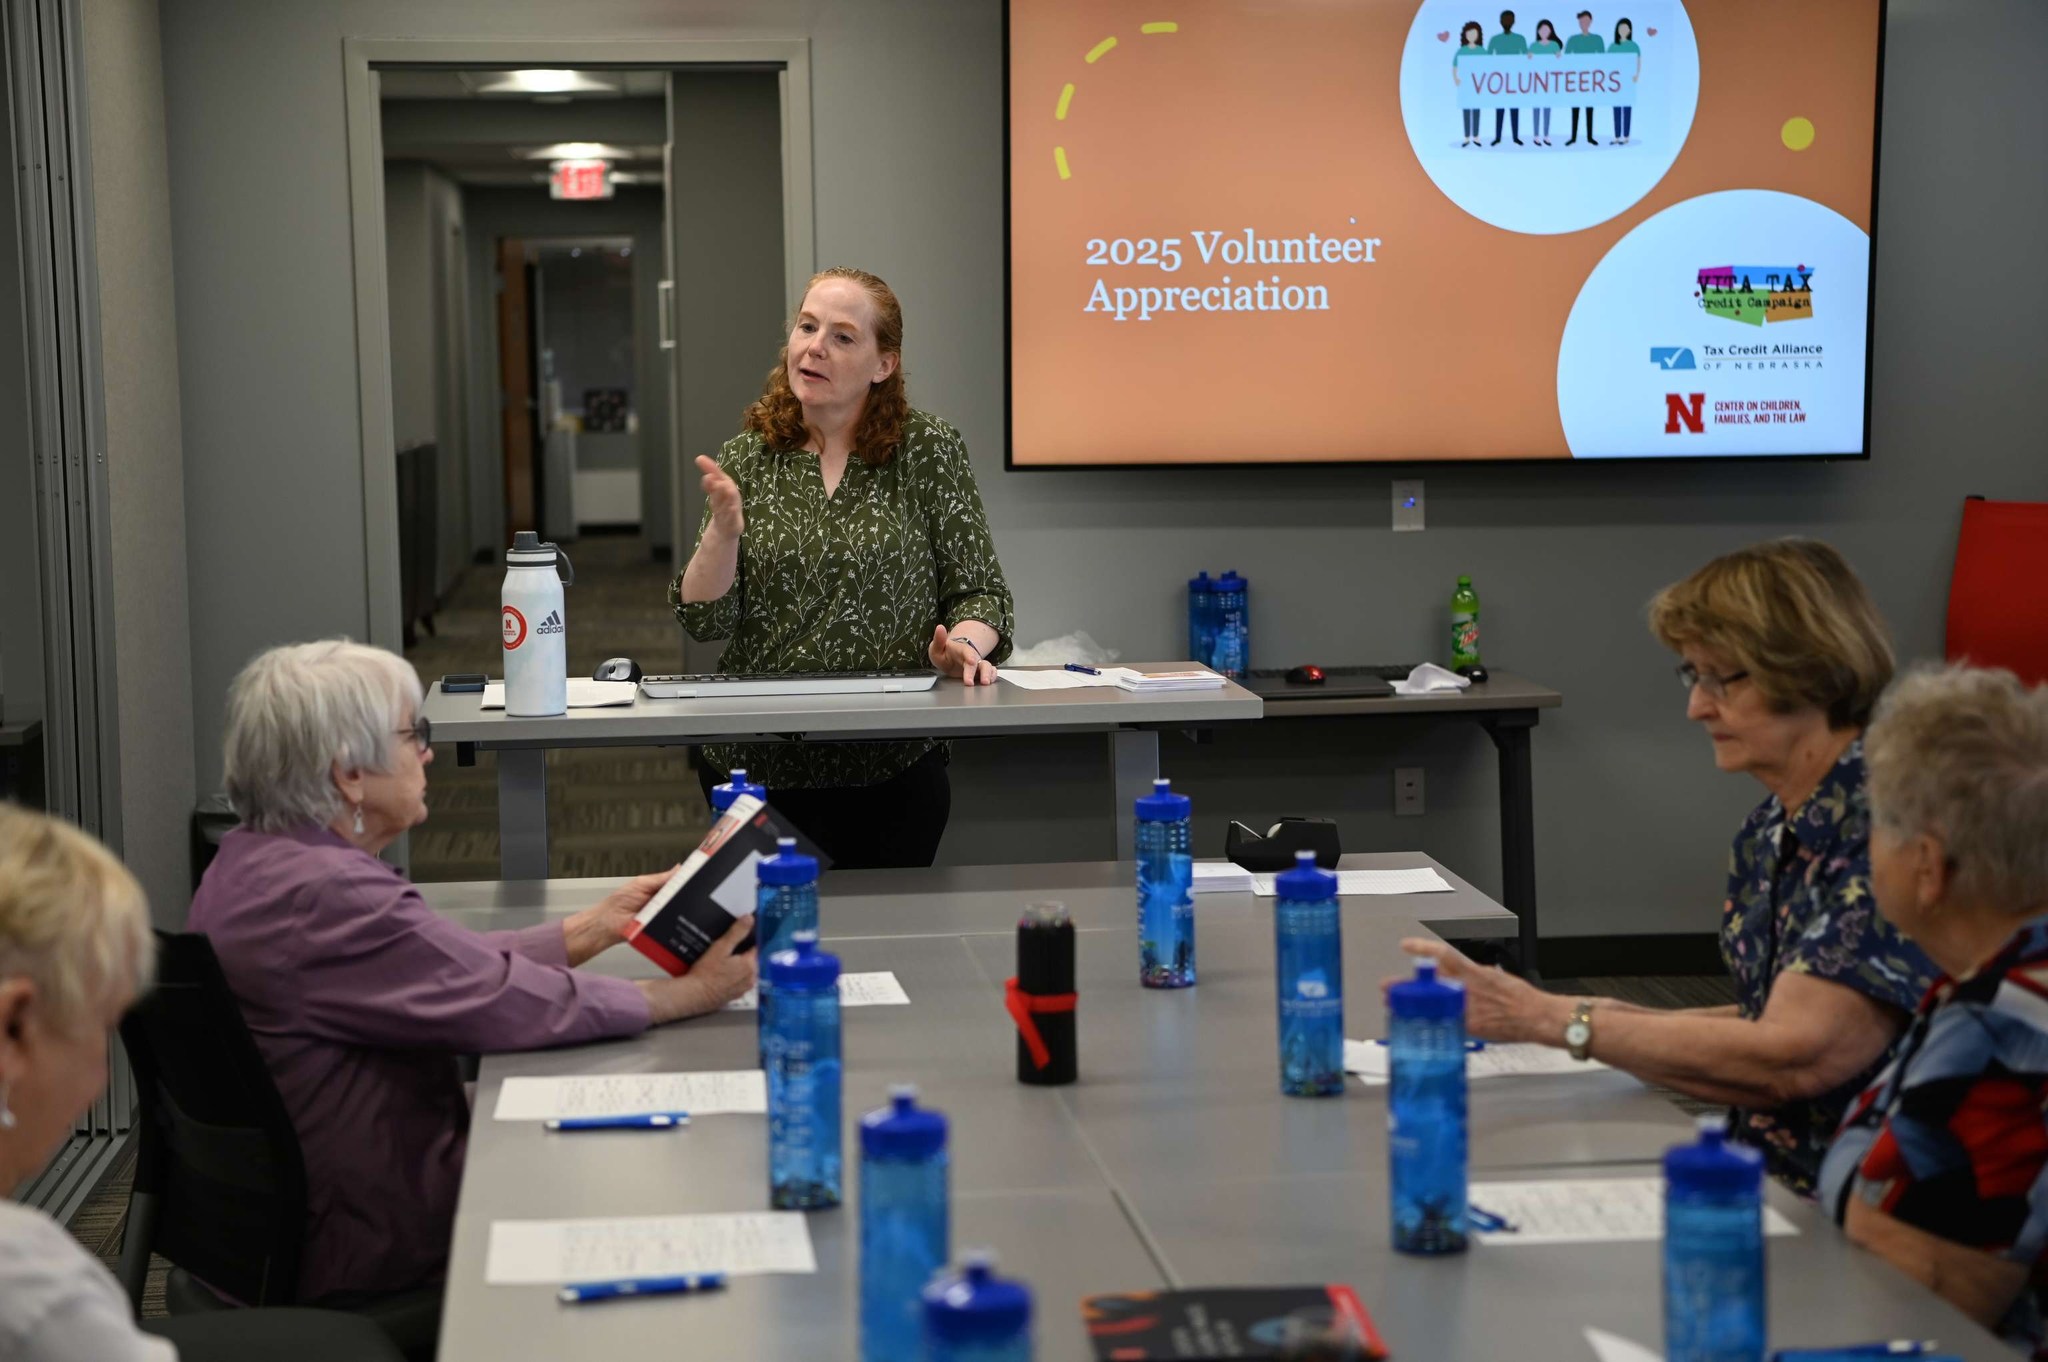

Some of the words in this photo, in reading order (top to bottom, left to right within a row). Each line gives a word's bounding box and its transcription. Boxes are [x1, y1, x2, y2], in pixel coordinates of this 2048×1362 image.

[1471, 69, 1621, 96] VOLUNTEERS
[1085, 238, 1182, 272] 2025
[1191, 227, 1381, 264] Volunteer
[1698, 274, 1754, 294] VITA
[1766, 273, 1813, 293] TAX
[1083, 275, 1330, 321] Appreciation
[1698, 297, 1741, 309] Credit
[1748, 296, 1810, 310] Campaign
[1703, 345, 1724, 356] Tax
[1729, 344, 1767, 355] Credit
[1772, 343, 1823, 354] Alliance
[1703, 363, 1722, 371] OF
[1735, 361, 1823, 370] NEBRASKA
[1665, 393, 1705, 433] N
[1714, 401, 1744, 411] CENTER
[1747, 401, 1758, 410] ON
[1753, 413, 1770, 423] AND
[1773, 413, 1787, 422] THE
[1789, 413, 1806, 423] LAW
